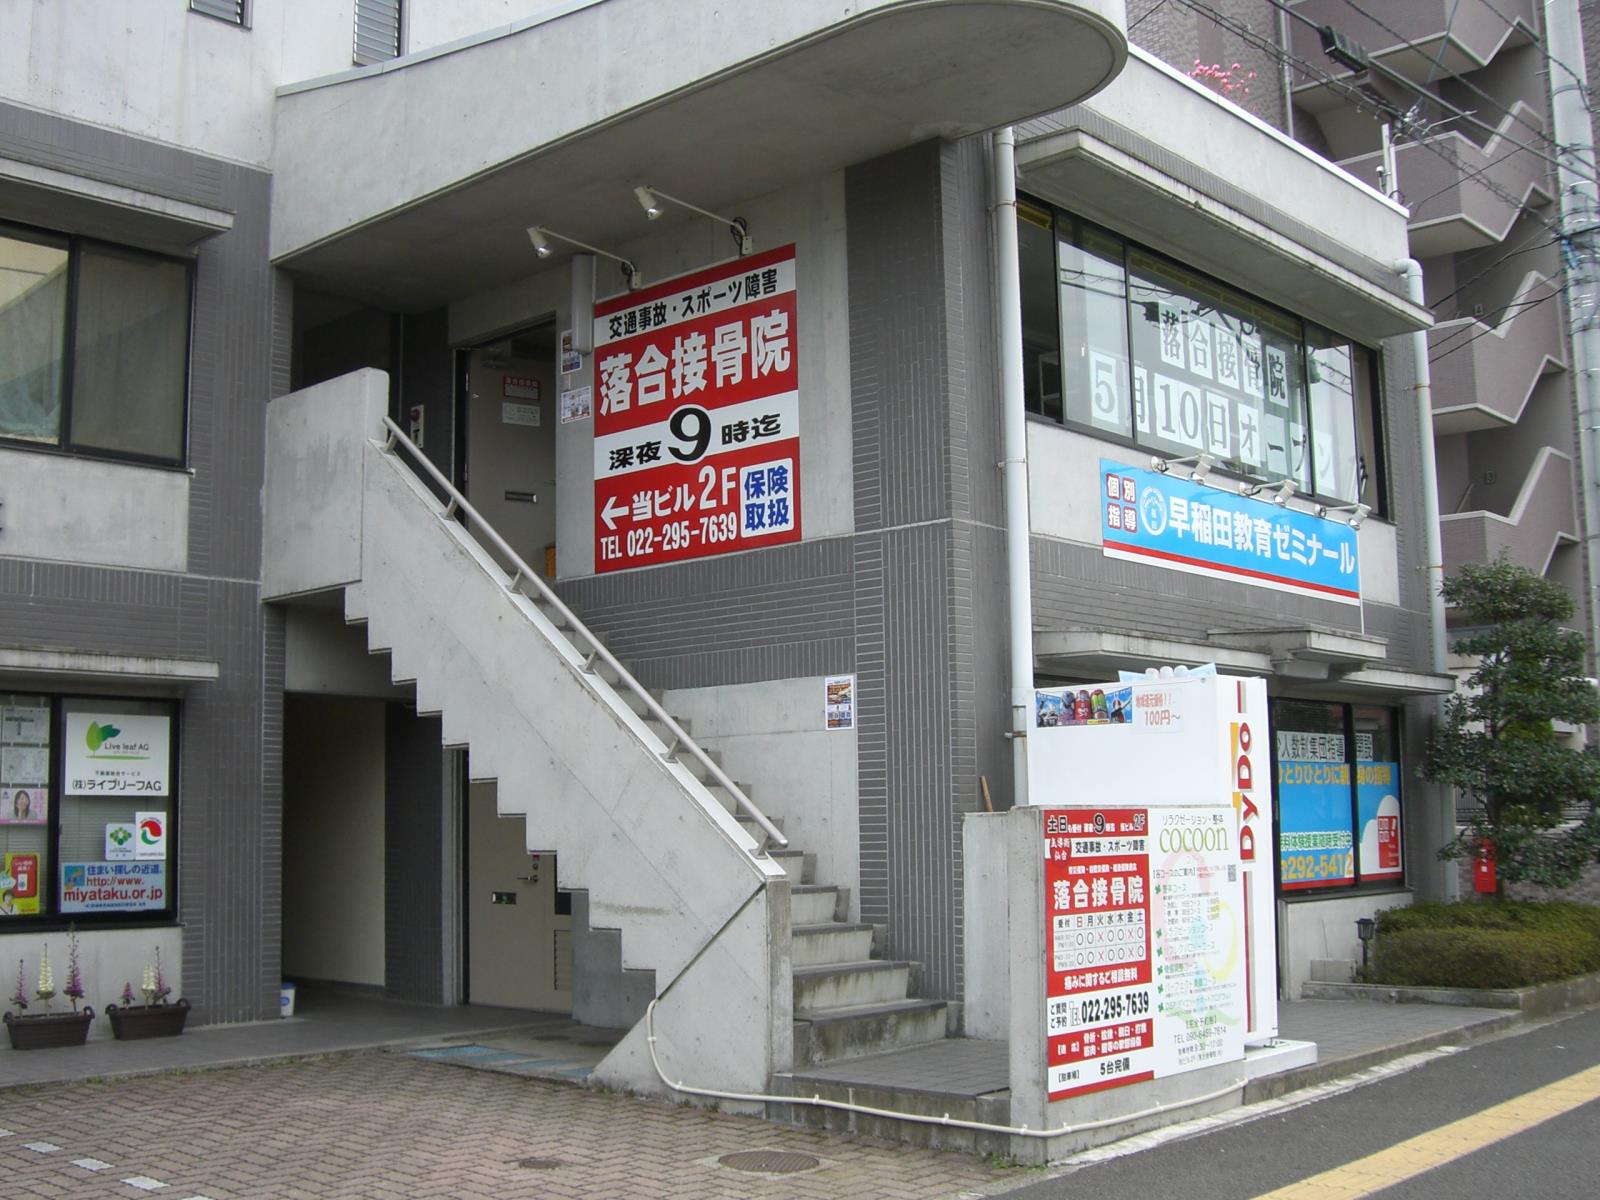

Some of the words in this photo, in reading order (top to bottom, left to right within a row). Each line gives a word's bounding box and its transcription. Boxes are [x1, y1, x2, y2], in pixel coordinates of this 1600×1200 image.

[609, 269, 777, 339] 交通事故・スポーツ障害
[600, 309, 791, 417] 落合接骨院
[608, 405, 781, 471] 深夜9時迄
[632, 465, 736, 522] 当ビル2F
[744, 467, 789, 500] 保険
[1107, 473, 1136, 503] 個別
[745, 498, 790, 532] 取扱
[1107, 503, 1137, 533] 指導
[601, 536, 623, 560] TEL
[626, 512, 737, 557] 022-295-7639
[1169, 496, 1355, 575] 早稲田教育ゼミナール
[104, 742, 120, 751] Live
[122, 742, 137, 751] leaf
[137, 743, 150, 751] AG
[1279, 734, 1345, 760] 人数制集団指導
[1160, 826, 1229, 854] cocoon
[63, 885, 163, 904] miyataku.or.jp
[1053, 875, 1145, 911] 落合接骨院
[1081, 991, 1149, 1024] 022-295-7639
[1099, 1057, 1130, 1075] 5台完備
